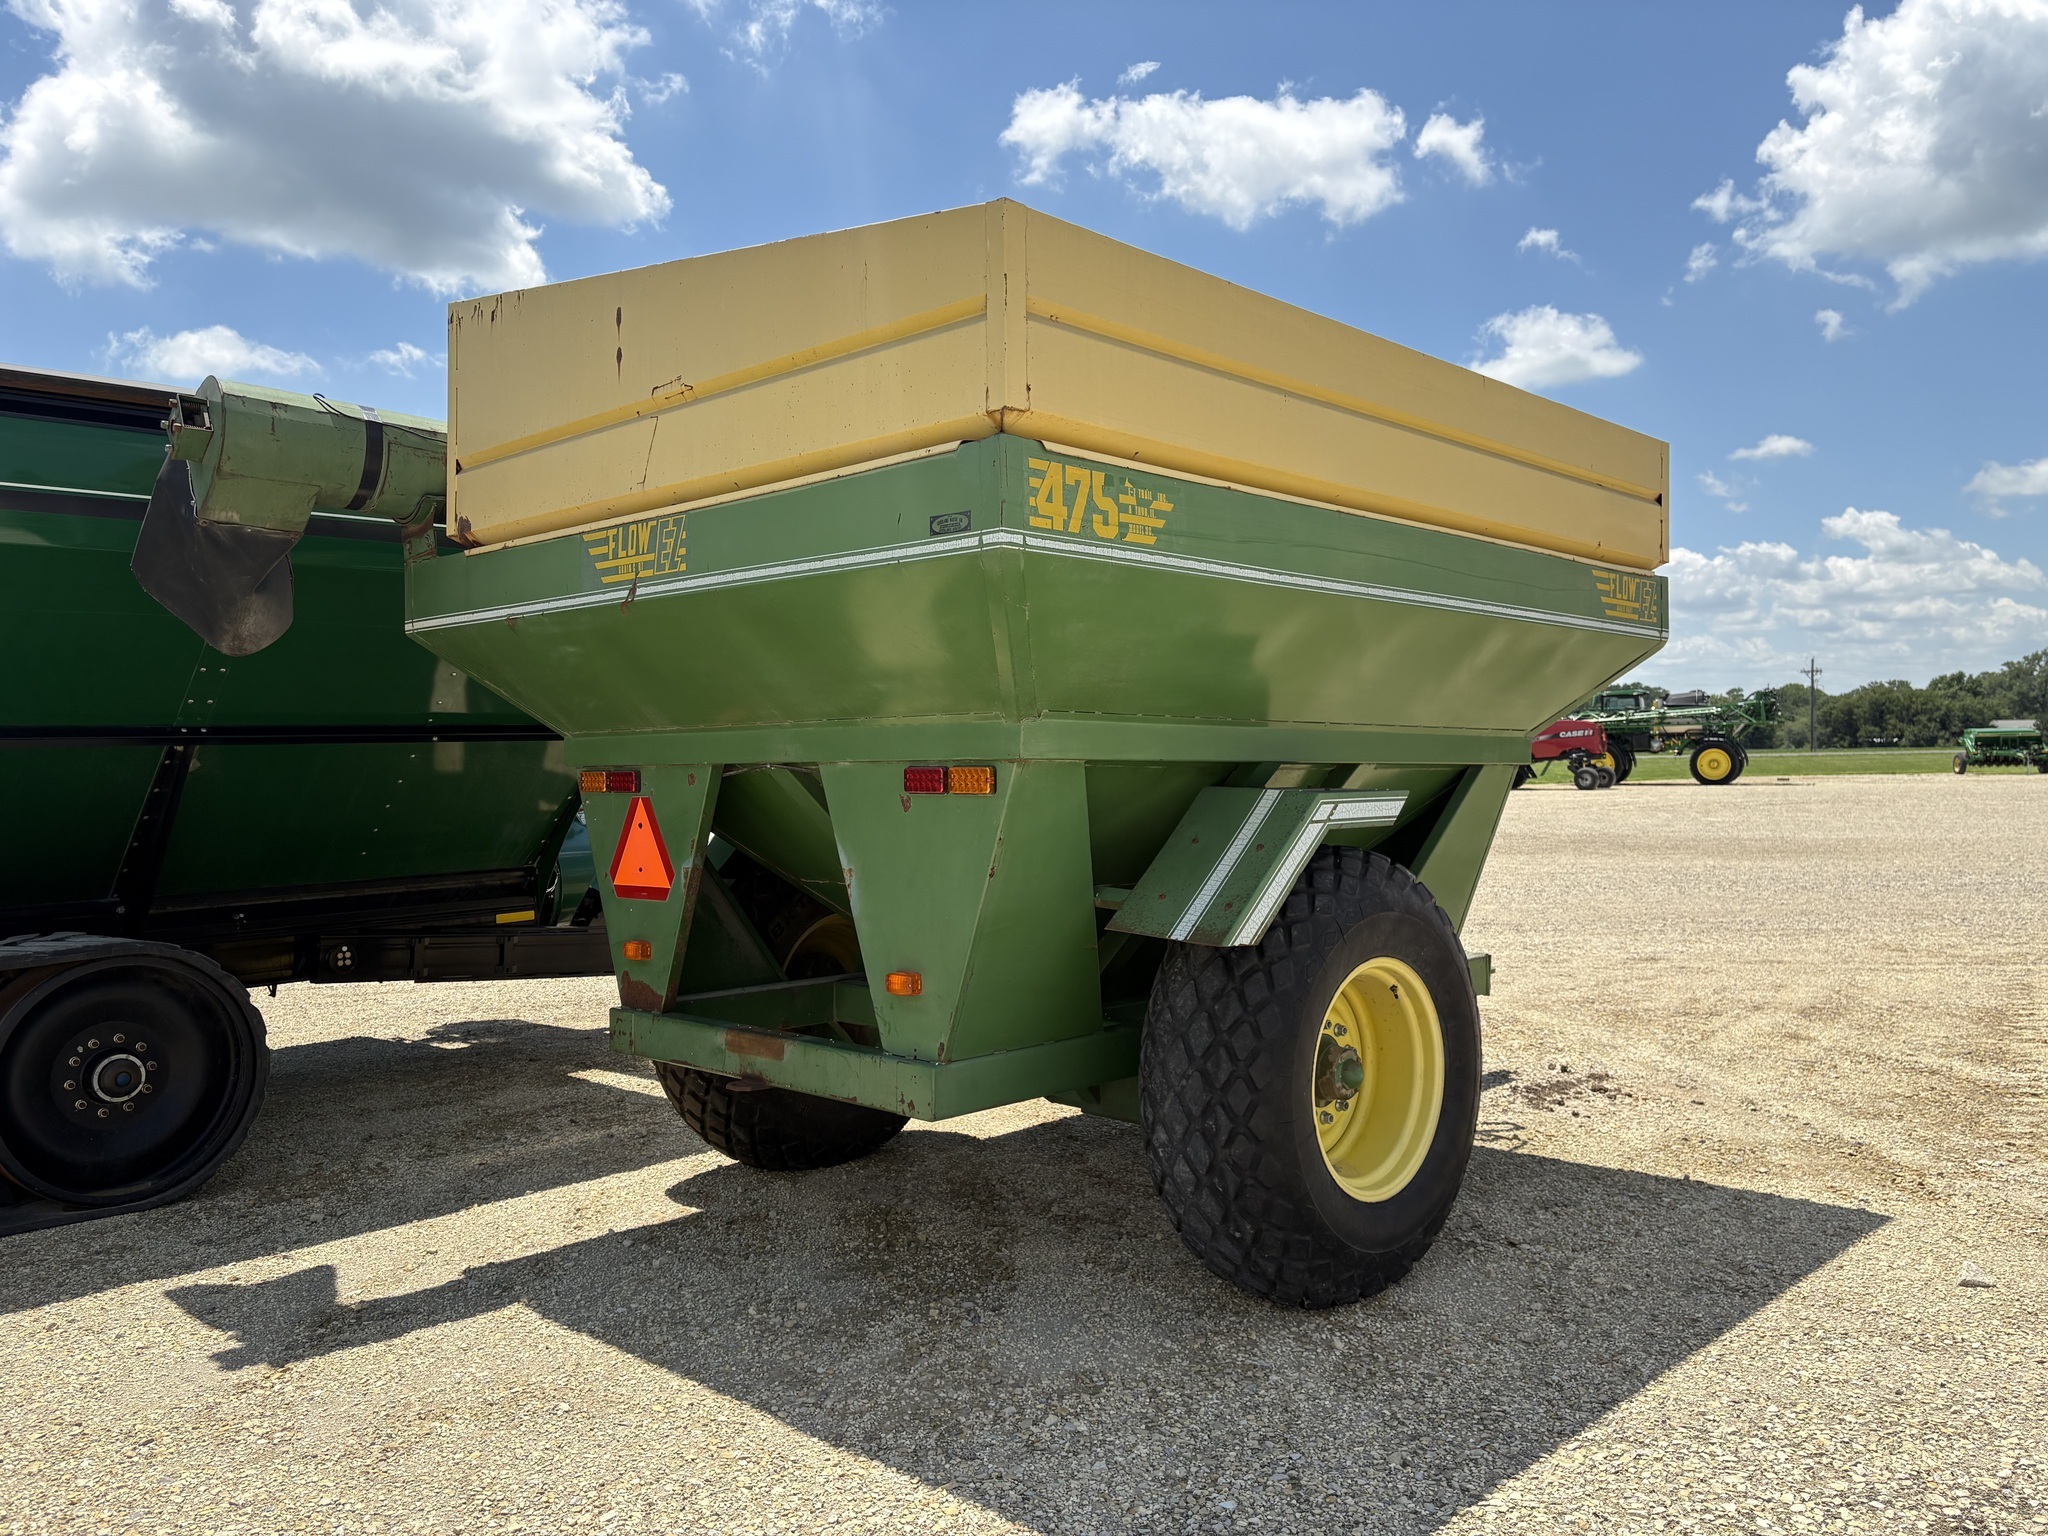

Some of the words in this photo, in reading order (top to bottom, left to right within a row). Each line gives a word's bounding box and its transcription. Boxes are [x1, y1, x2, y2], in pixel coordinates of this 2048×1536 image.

[1036, 461, 1119, 539] 475
[606, 520, 656, 560] FLOW
[654, 515, 685, 575] EZ
[1608, 573, 1640, 602] FLOW
[1559, 729, 1584, 738] CASE
[1584, 728, 1594, 736] IH
